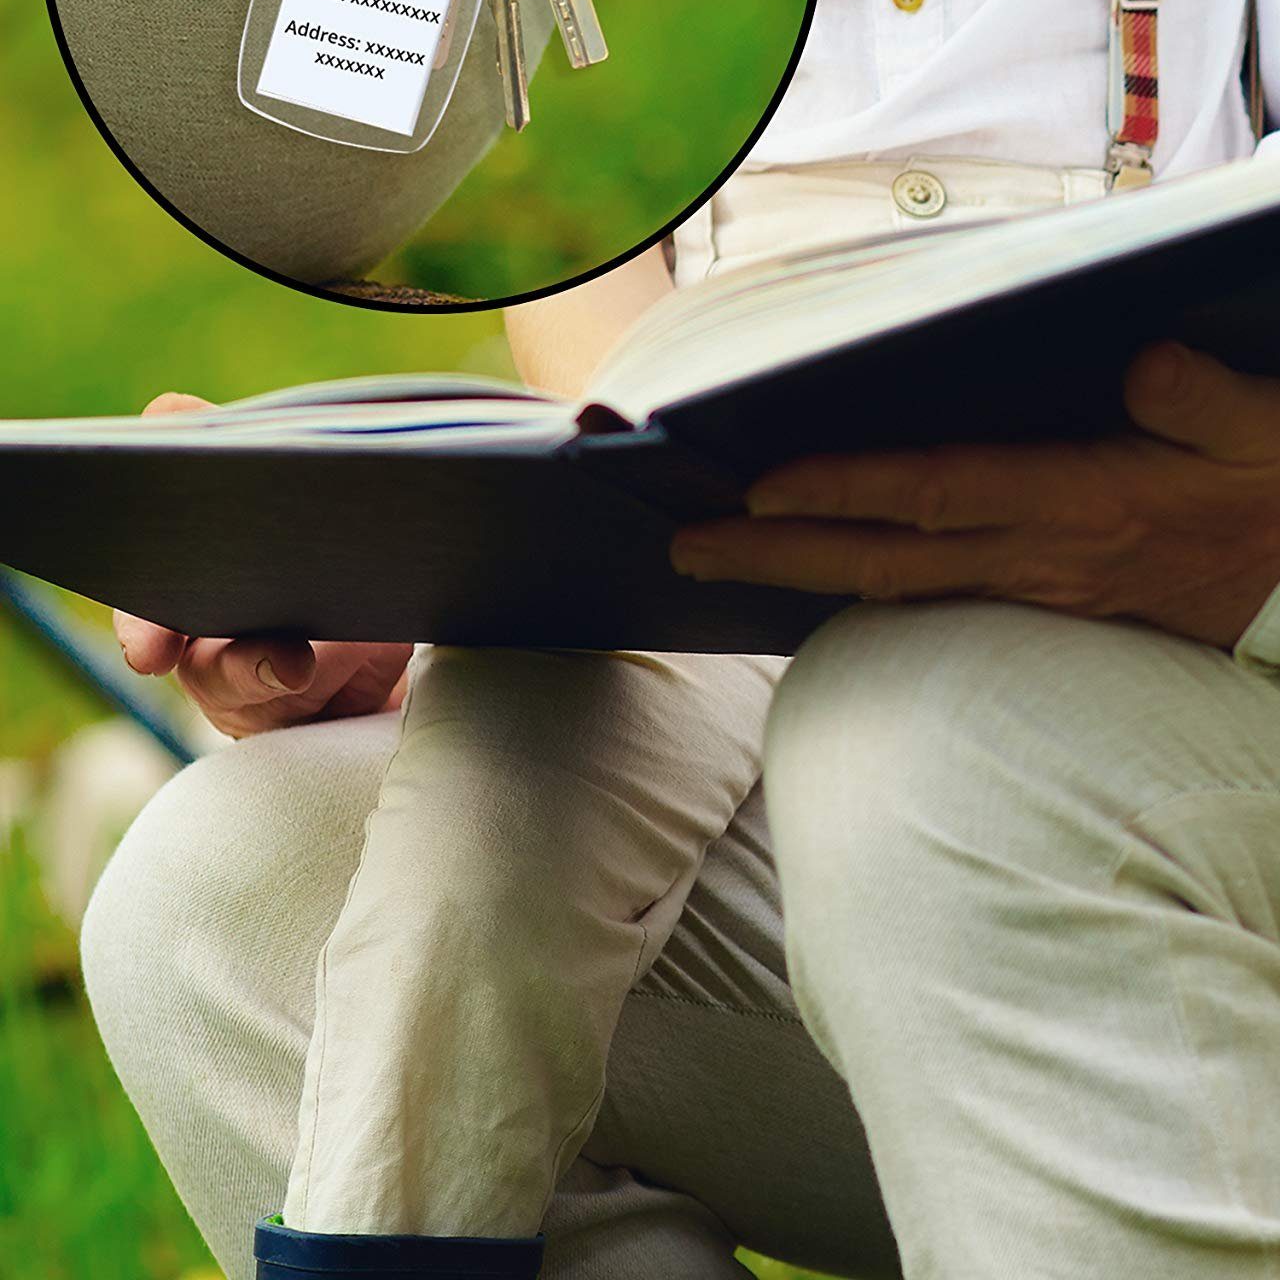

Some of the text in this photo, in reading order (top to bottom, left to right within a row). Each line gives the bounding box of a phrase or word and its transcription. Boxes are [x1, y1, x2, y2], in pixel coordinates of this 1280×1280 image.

[284, 19, 426, 66] Address: xxxxxx
[314, 51, 386, 80] xxxxxxx
